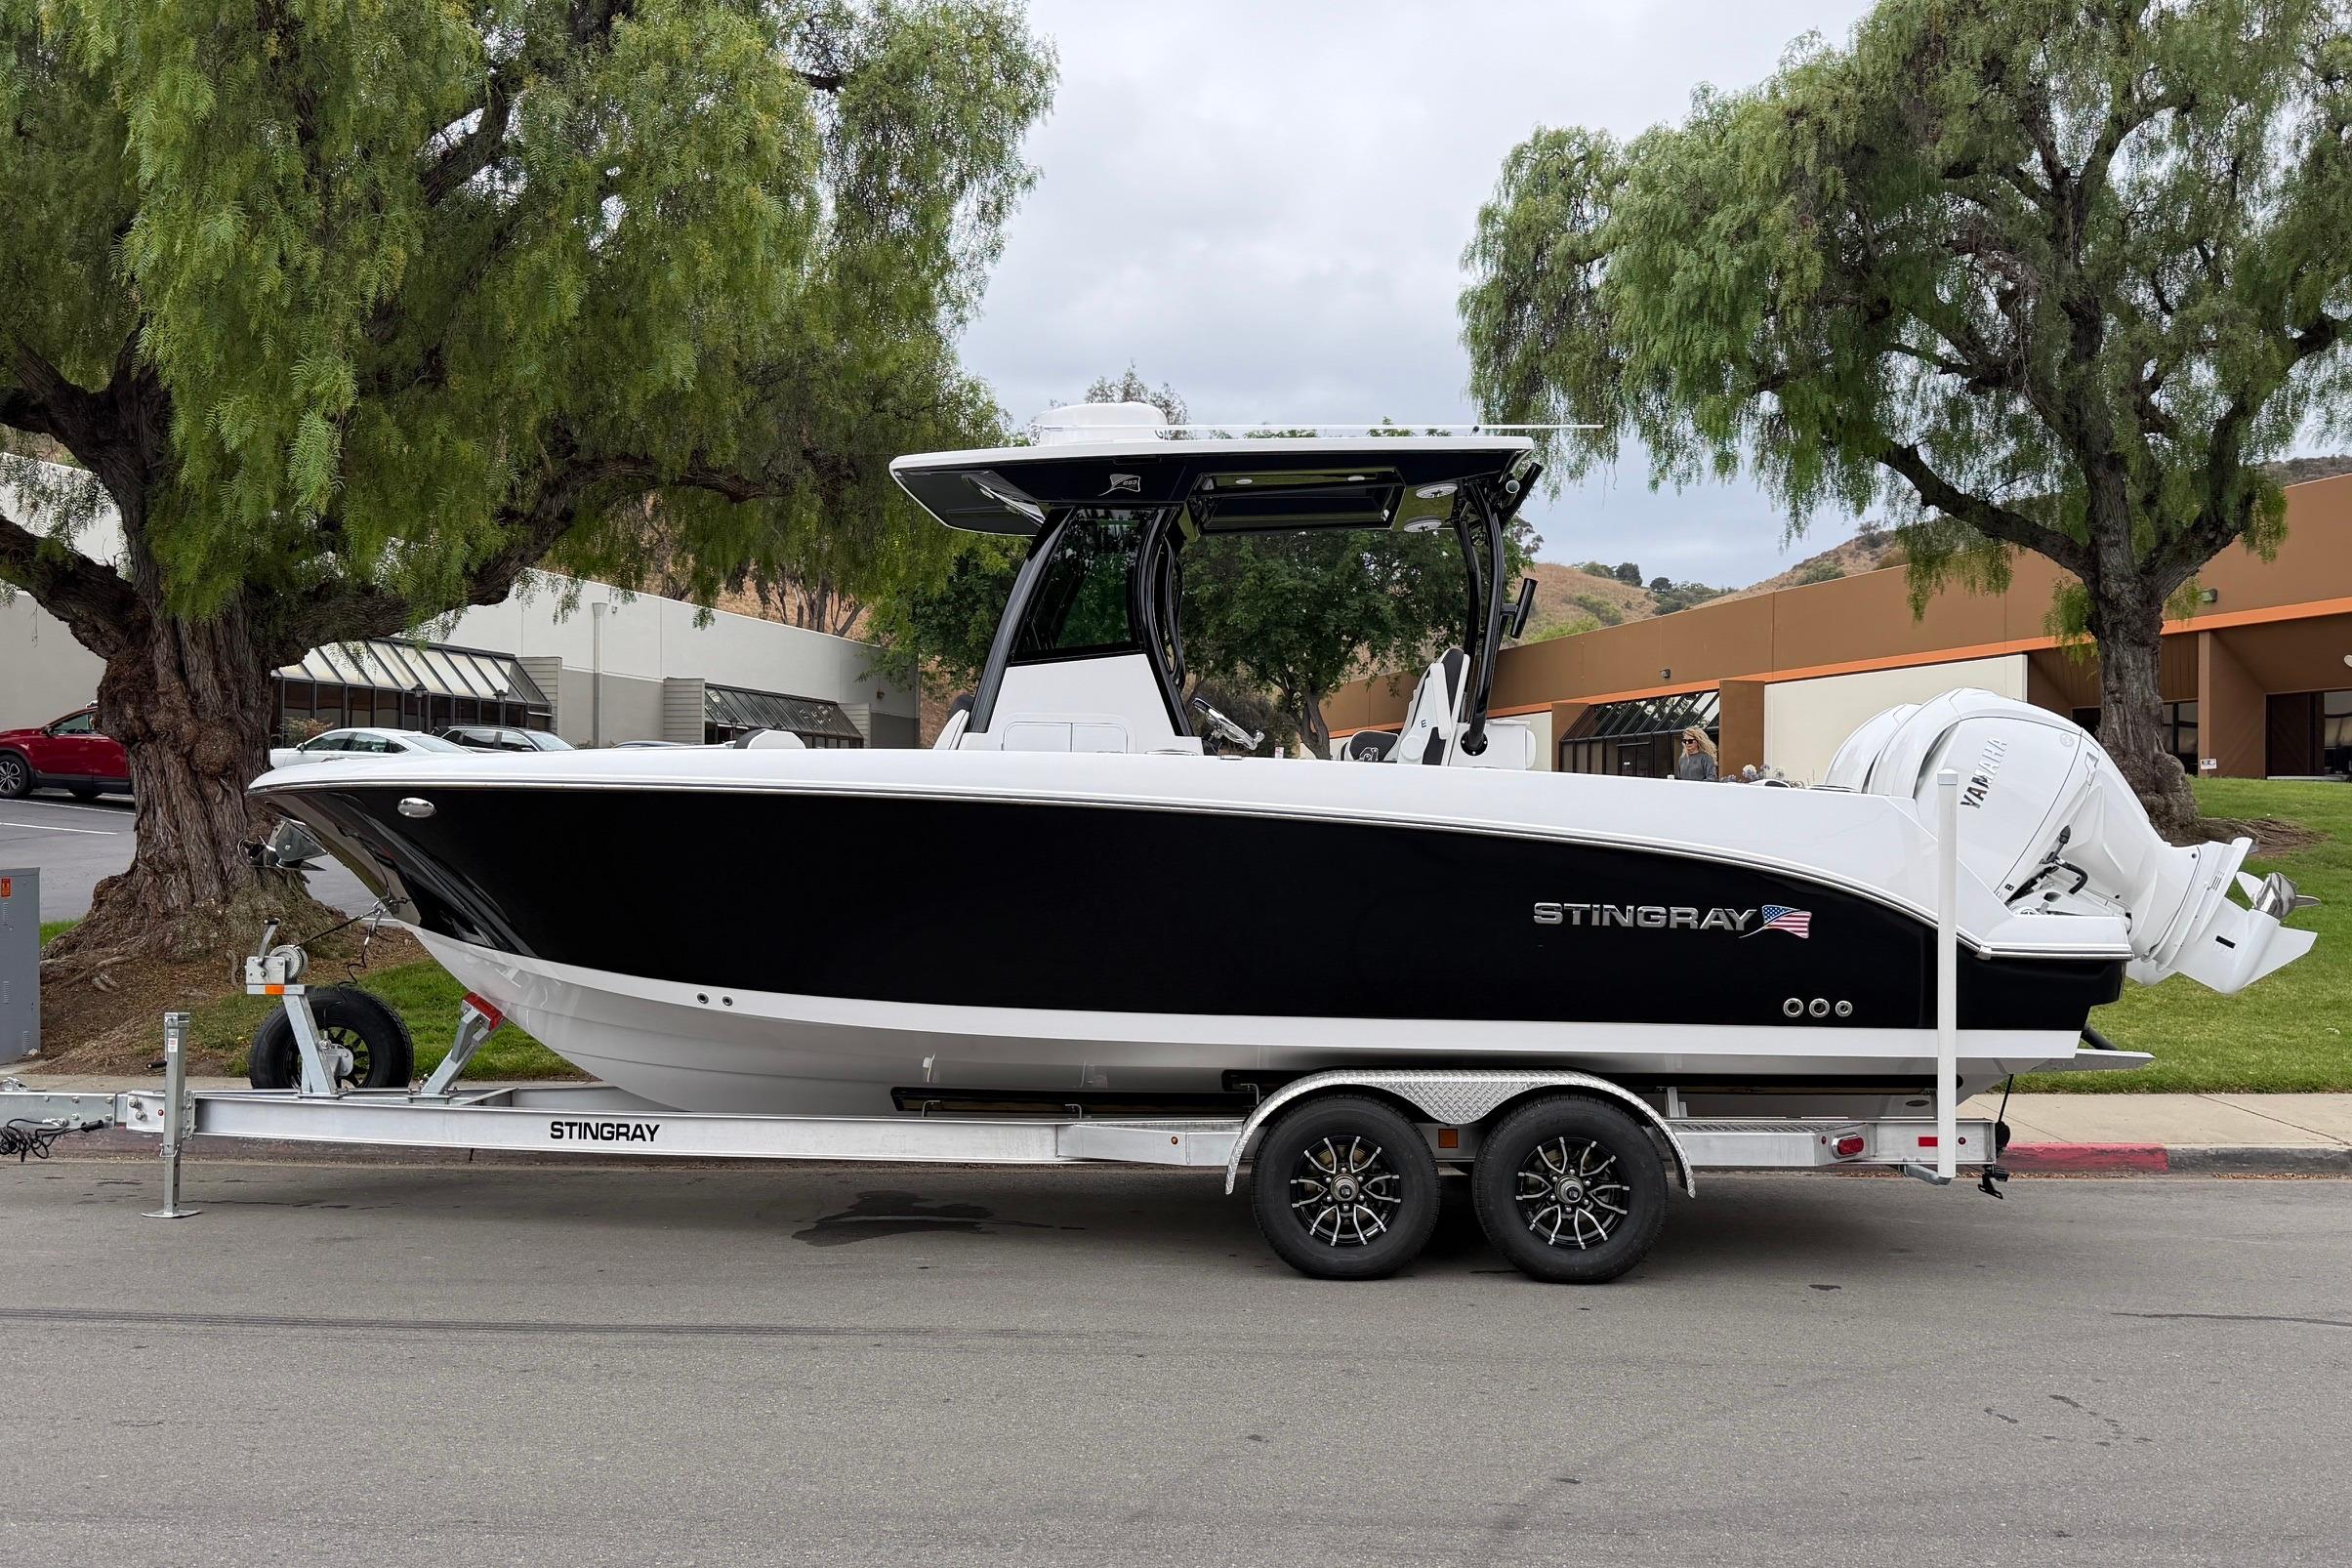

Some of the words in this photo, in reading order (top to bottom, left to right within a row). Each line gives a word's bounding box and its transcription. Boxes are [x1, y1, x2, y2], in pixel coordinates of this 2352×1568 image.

[1960, 737, 2007, 809] YAMAHA
[1533, 902, 1757, 930] STINGRAY
[550, 1121, 661, 1142] STINGRAY
